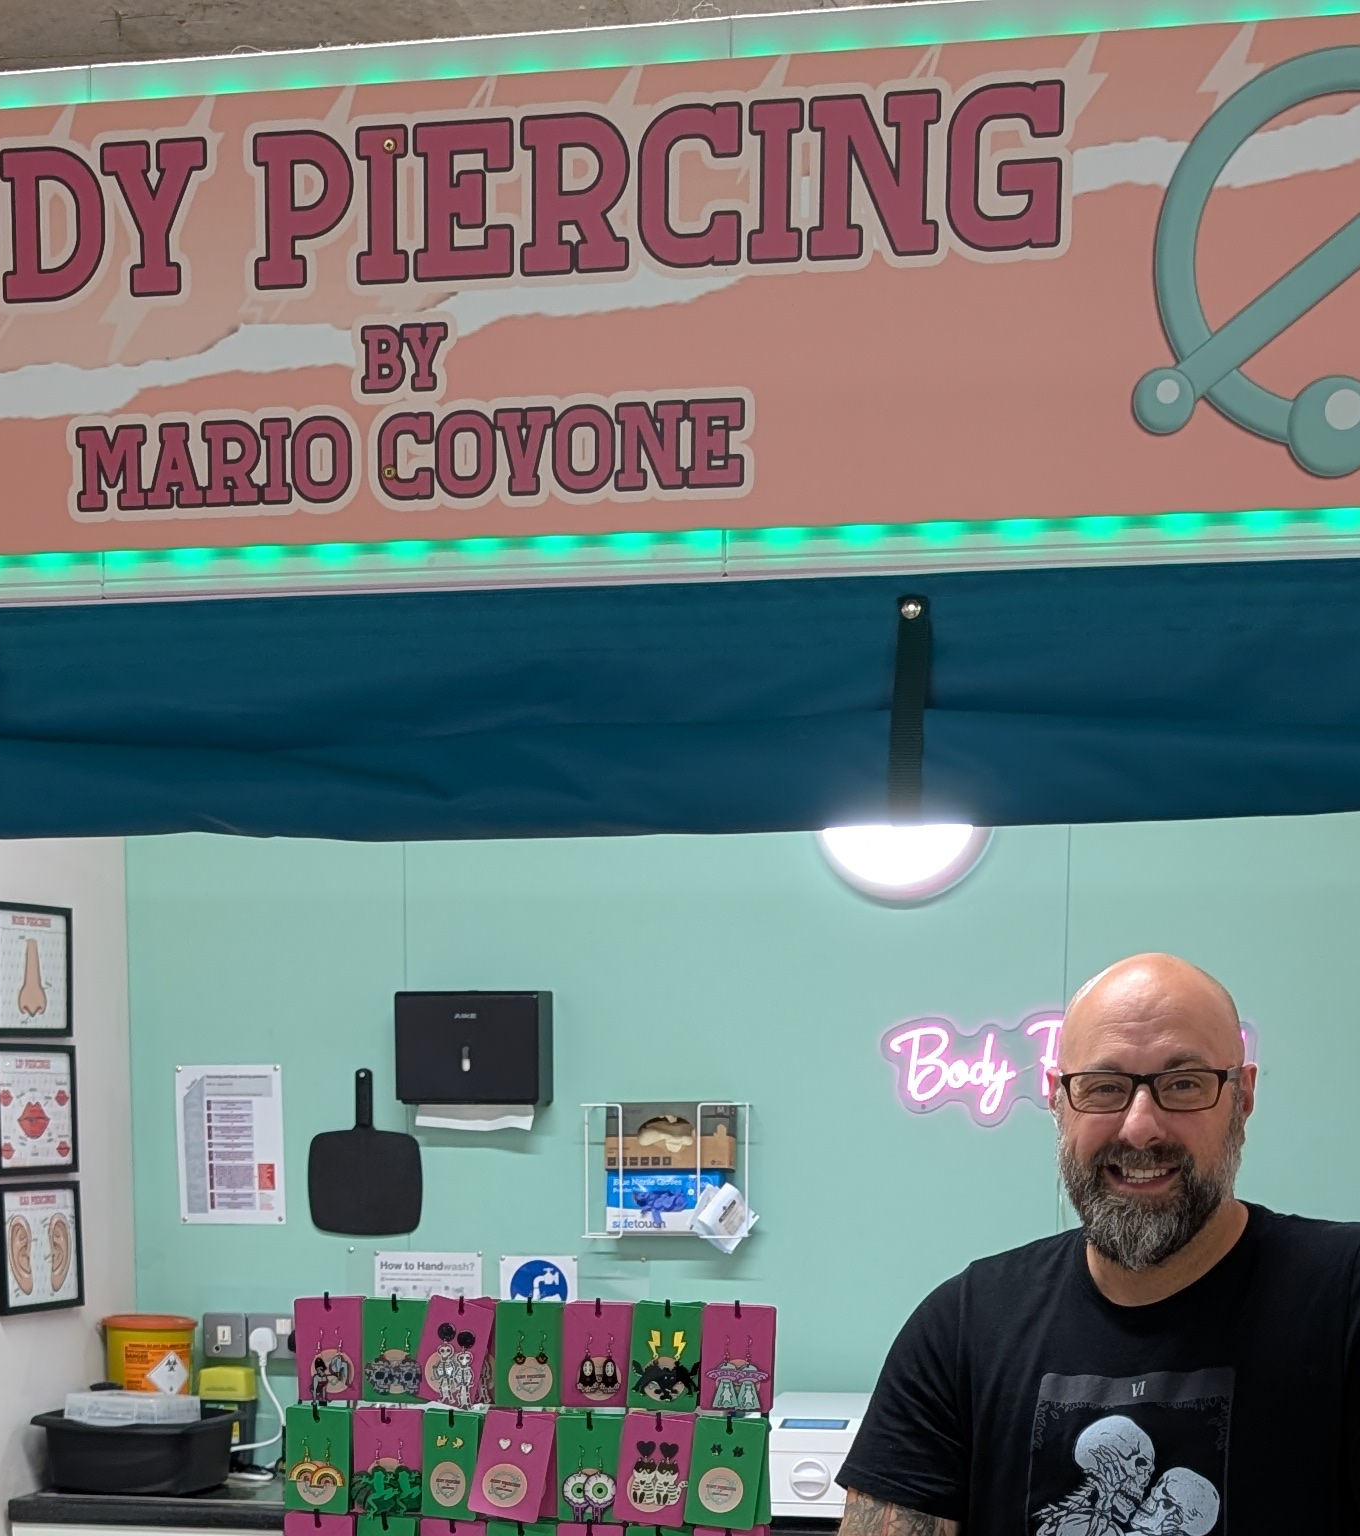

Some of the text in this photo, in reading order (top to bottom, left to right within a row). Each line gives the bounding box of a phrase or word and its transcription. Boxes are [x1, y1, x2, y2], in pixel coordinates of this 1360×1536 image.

[253, 80, 1067, 291] PIERCING
[360, 321, 448, 397] BY
[76, 397, 746, 514] MARIO COVONE
[890, 1025, 1017, 1116] Body
[380, 1260, 475, 1271] How to Handwash?
[1131, 1381, 1147, 1398] VI
